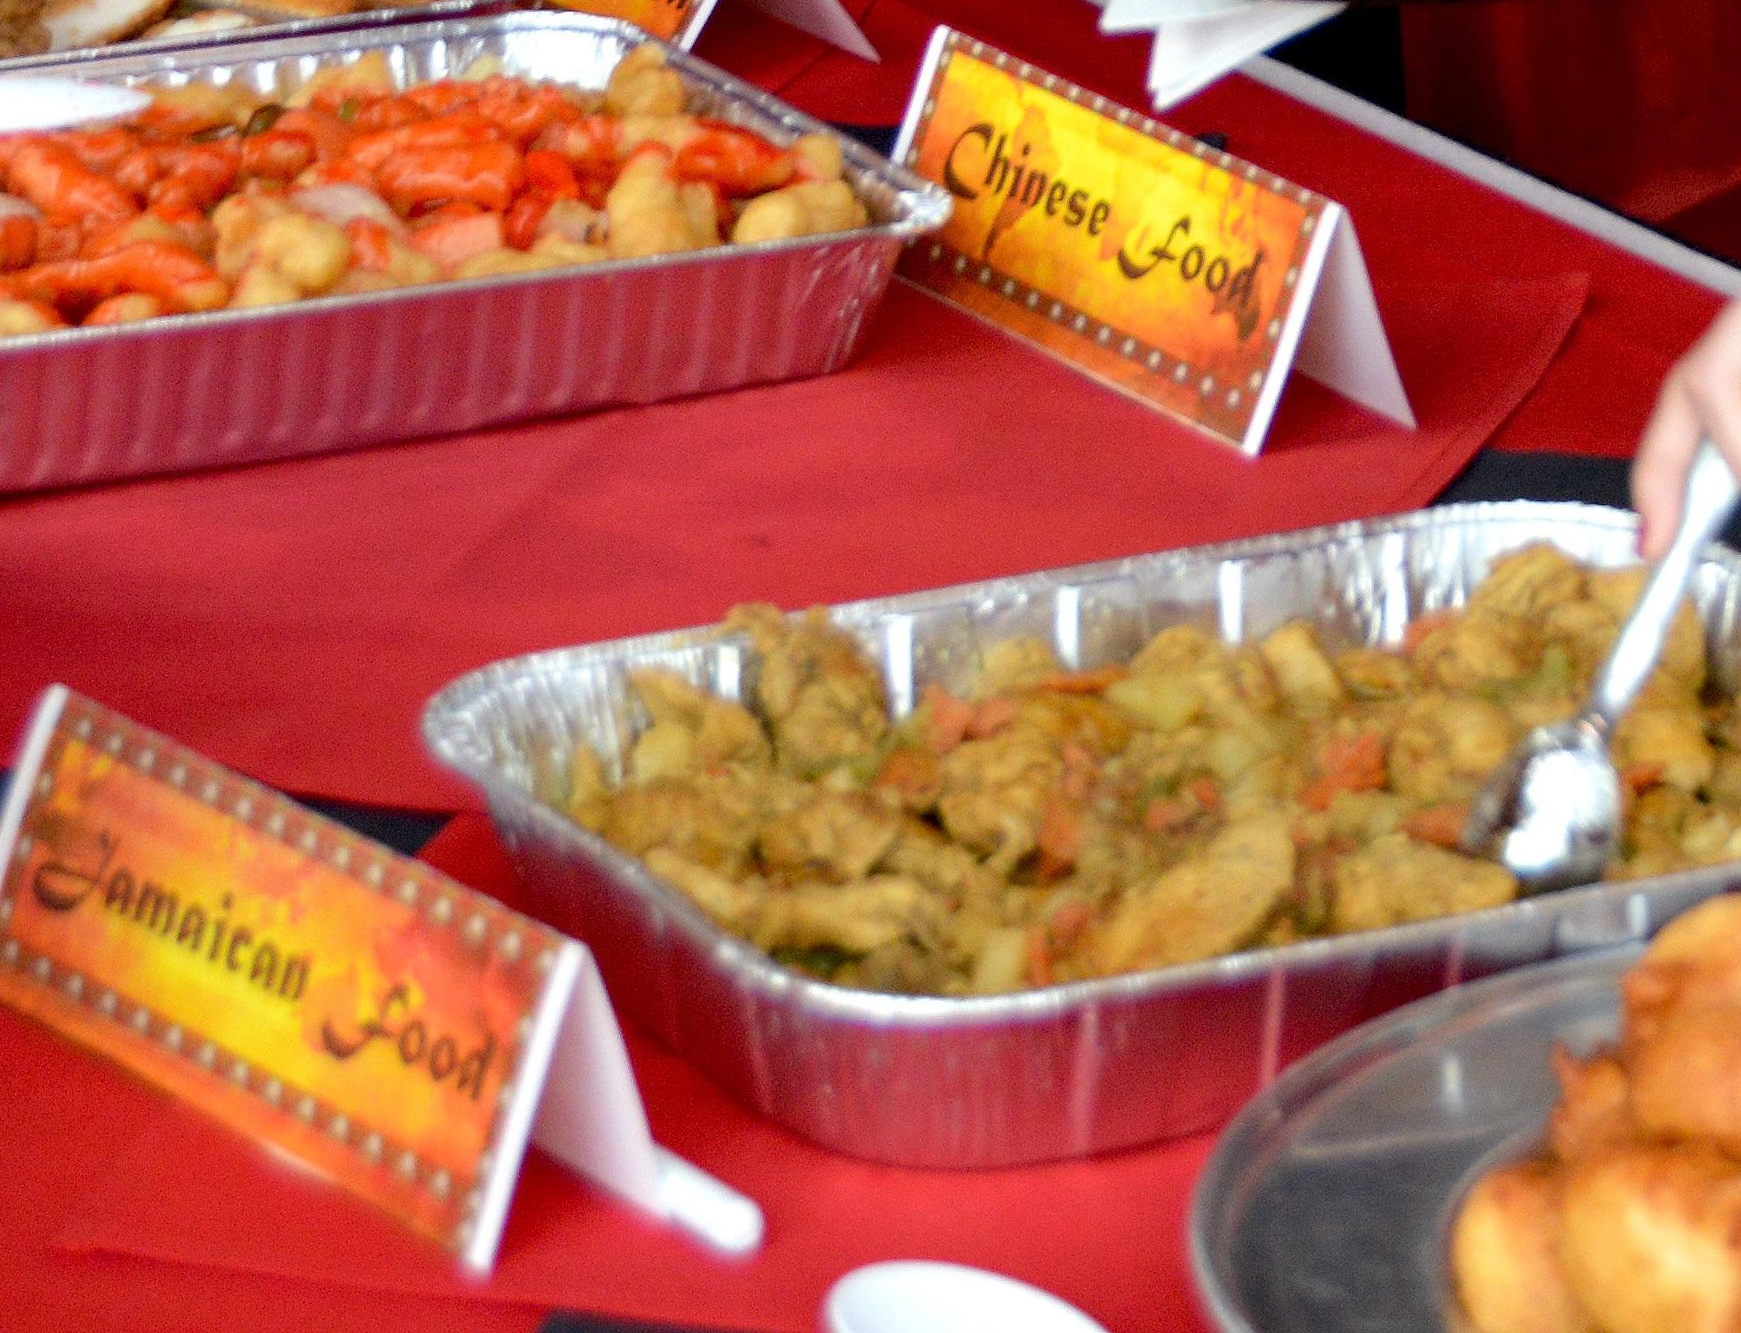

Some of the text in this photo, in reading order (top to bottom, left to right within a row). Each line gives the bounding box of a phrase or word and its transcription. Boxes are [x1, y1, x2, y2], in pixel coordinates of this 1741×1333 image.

[943, 123, 1265, 311] Chinese Food
[32, 829, 497, 1103] Jamaican Food
